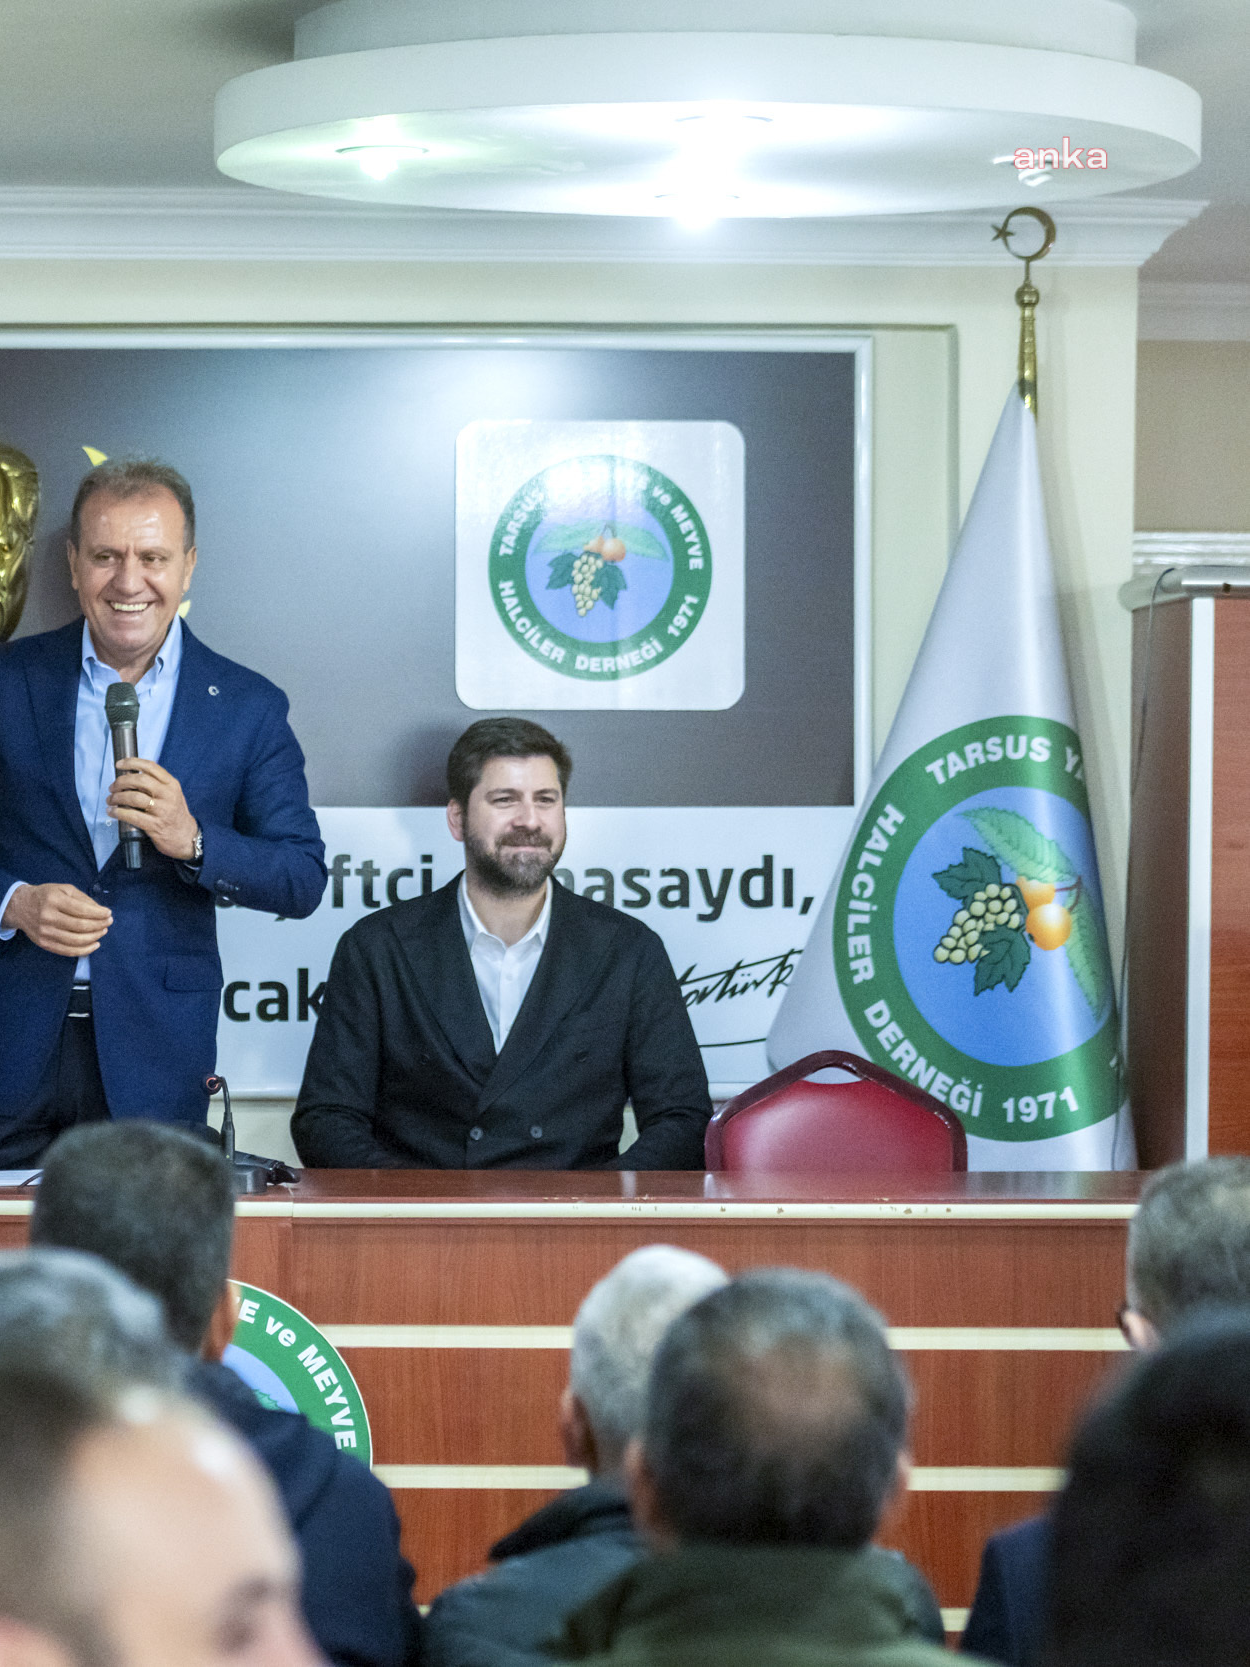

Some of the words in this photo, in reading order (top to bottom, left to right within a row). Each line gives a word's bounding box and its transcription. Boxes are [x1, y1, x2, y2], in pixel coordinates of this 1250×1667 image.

[651, 485, 672, 506] ve
[670, 504, 704, 570] MEYVE
[574, 637, 664, 673] DERNEĞİ
[667, 594, 699, 637] 1971
[925, 735, 1051, 785] TARSUS
[553, 855, 814, 922] asaydı,
[863, 999, 983, 1118] DERNEĞİ
[1002, 1086, 1079, 1123] 1971
[265, 1316, 296, 1347] ve
[297, 1344, 357, 1450] MEYVE
